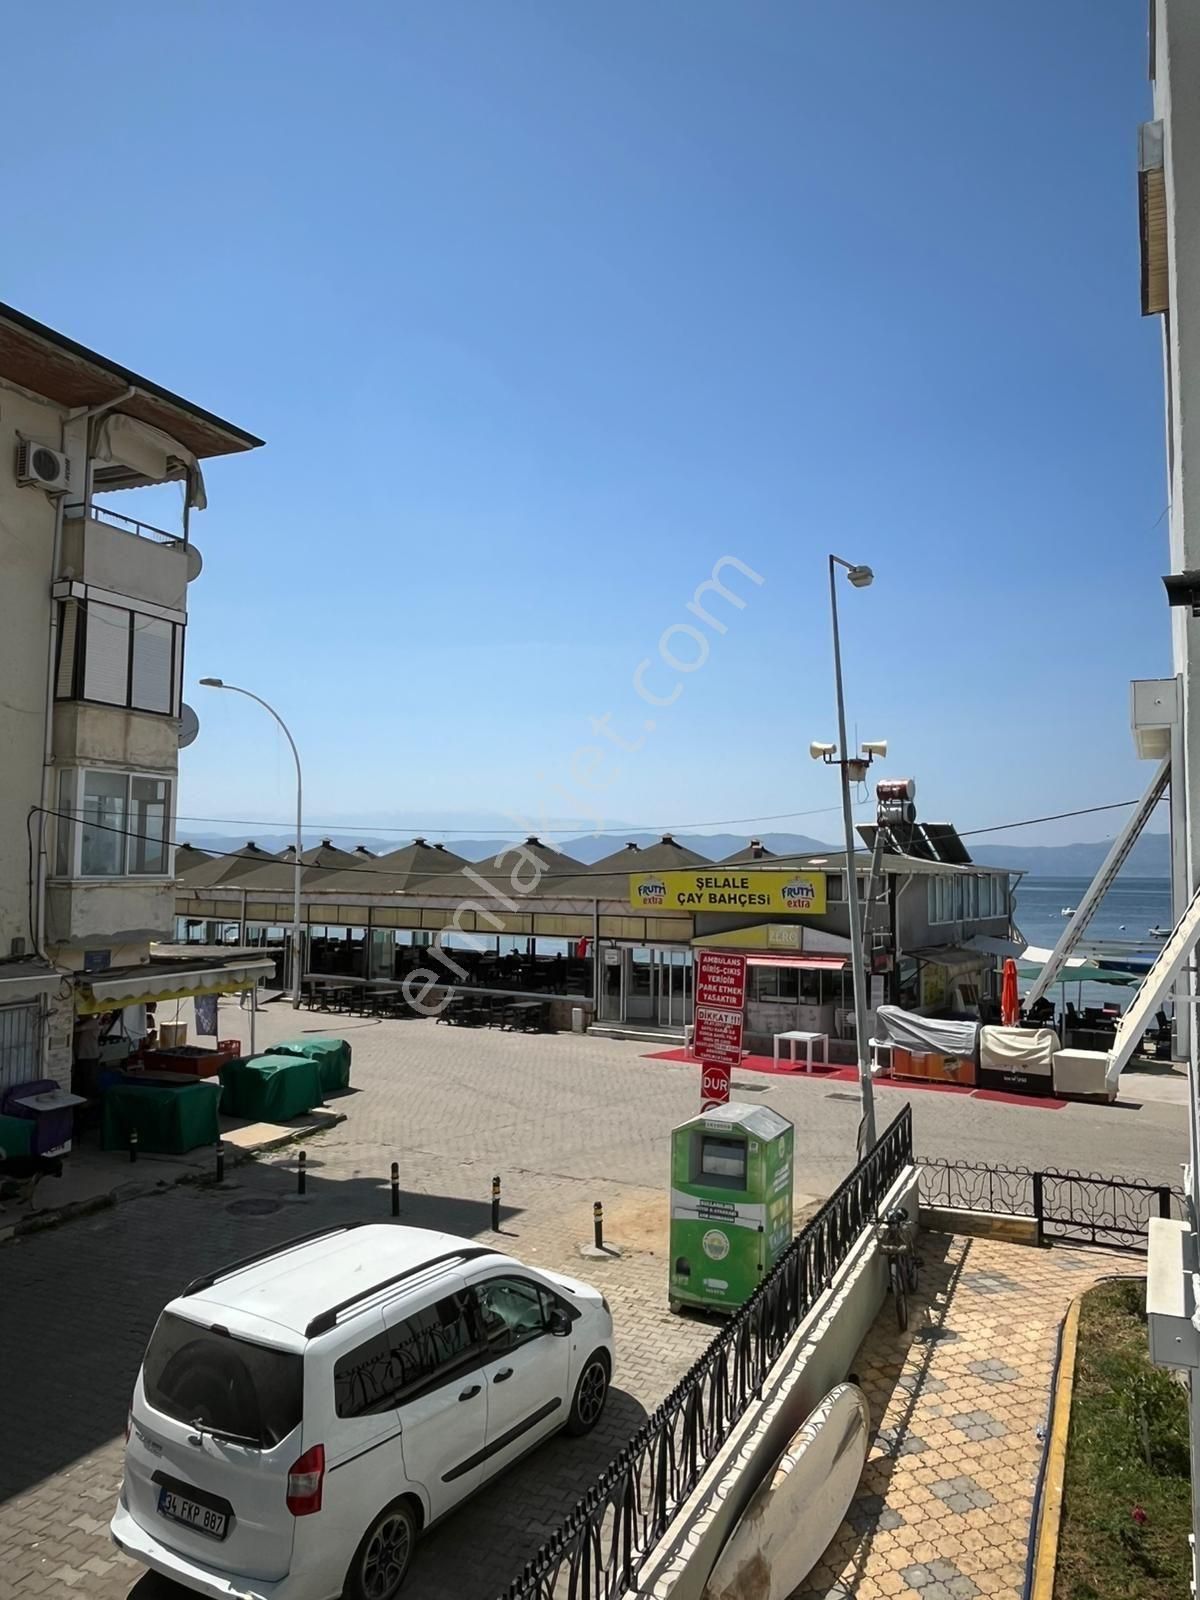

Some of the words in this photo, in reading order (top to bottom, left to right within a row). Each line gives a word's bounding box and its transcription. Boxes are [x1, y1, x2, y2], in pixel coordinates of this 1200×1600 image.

[696, 877, 749, 891] ŞELALE
[643, 896, 663, 905] extra
[677, 892, 703, 906] ÇAY
[787, 899, 811, 909] extra
[703, 956, 741, 966] AMBULANS
[699, 983, 718, 992] PARK
[719, 985, 742, 995] ETMEK
[703, 993, 737, 1004] YASAKTIR
[699, 1009, 728, 1022] DİKKAT
[704, 1076, 728, 1091] DUR
[165, 1494, 177, 1513] 34
[181, 1501, 200, 1521] FKP
[204, 1510, 223, 1532] 887
